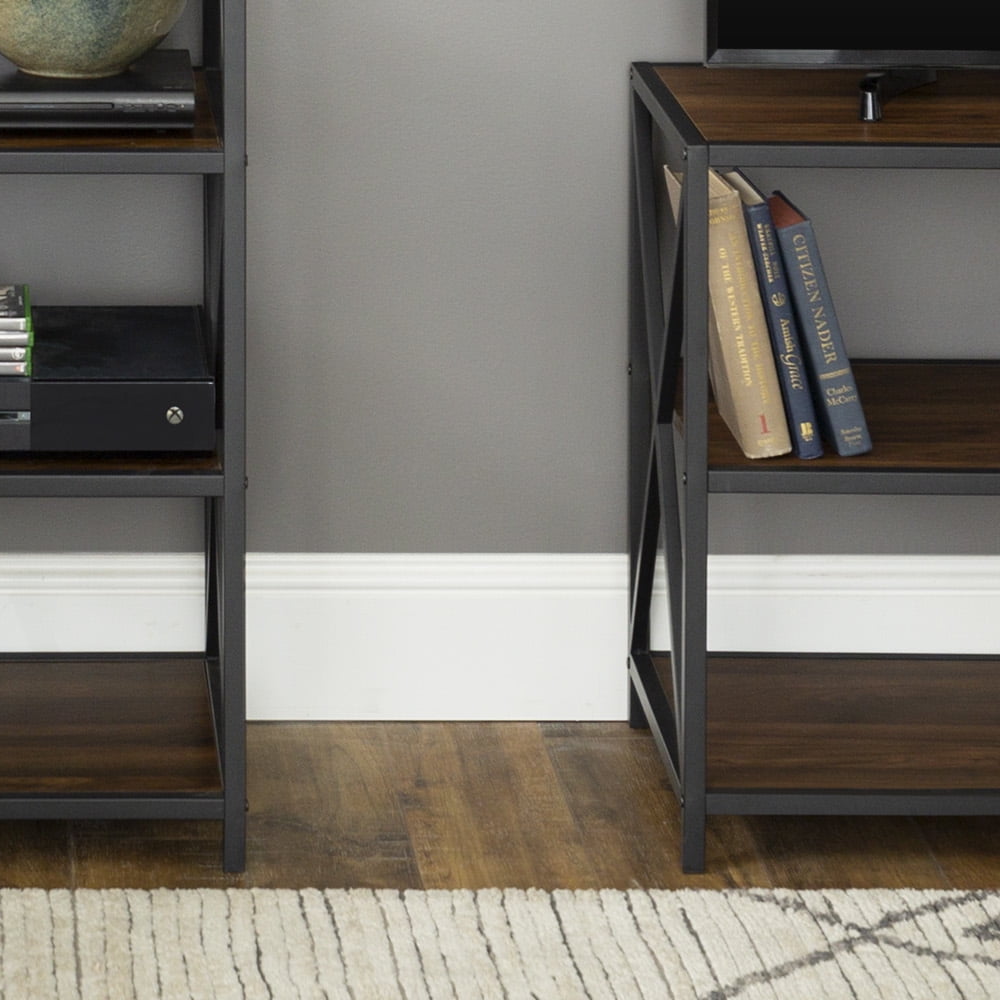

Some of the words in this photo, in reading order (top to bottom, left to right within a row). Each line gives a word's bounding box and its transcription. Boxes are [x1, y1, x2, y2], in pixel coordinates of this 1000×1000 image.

[721, 263, 732, 281] THE
[726, 286, 742, 332] WESTERN
[792, 234, 821, 303] CITIZEN
[811, 305, 838, 365] NADER
[780, 318, 796, 353] Amish
[735, 334, 753, 388] TRADITION
[780, 353, 803, 390] Grace
